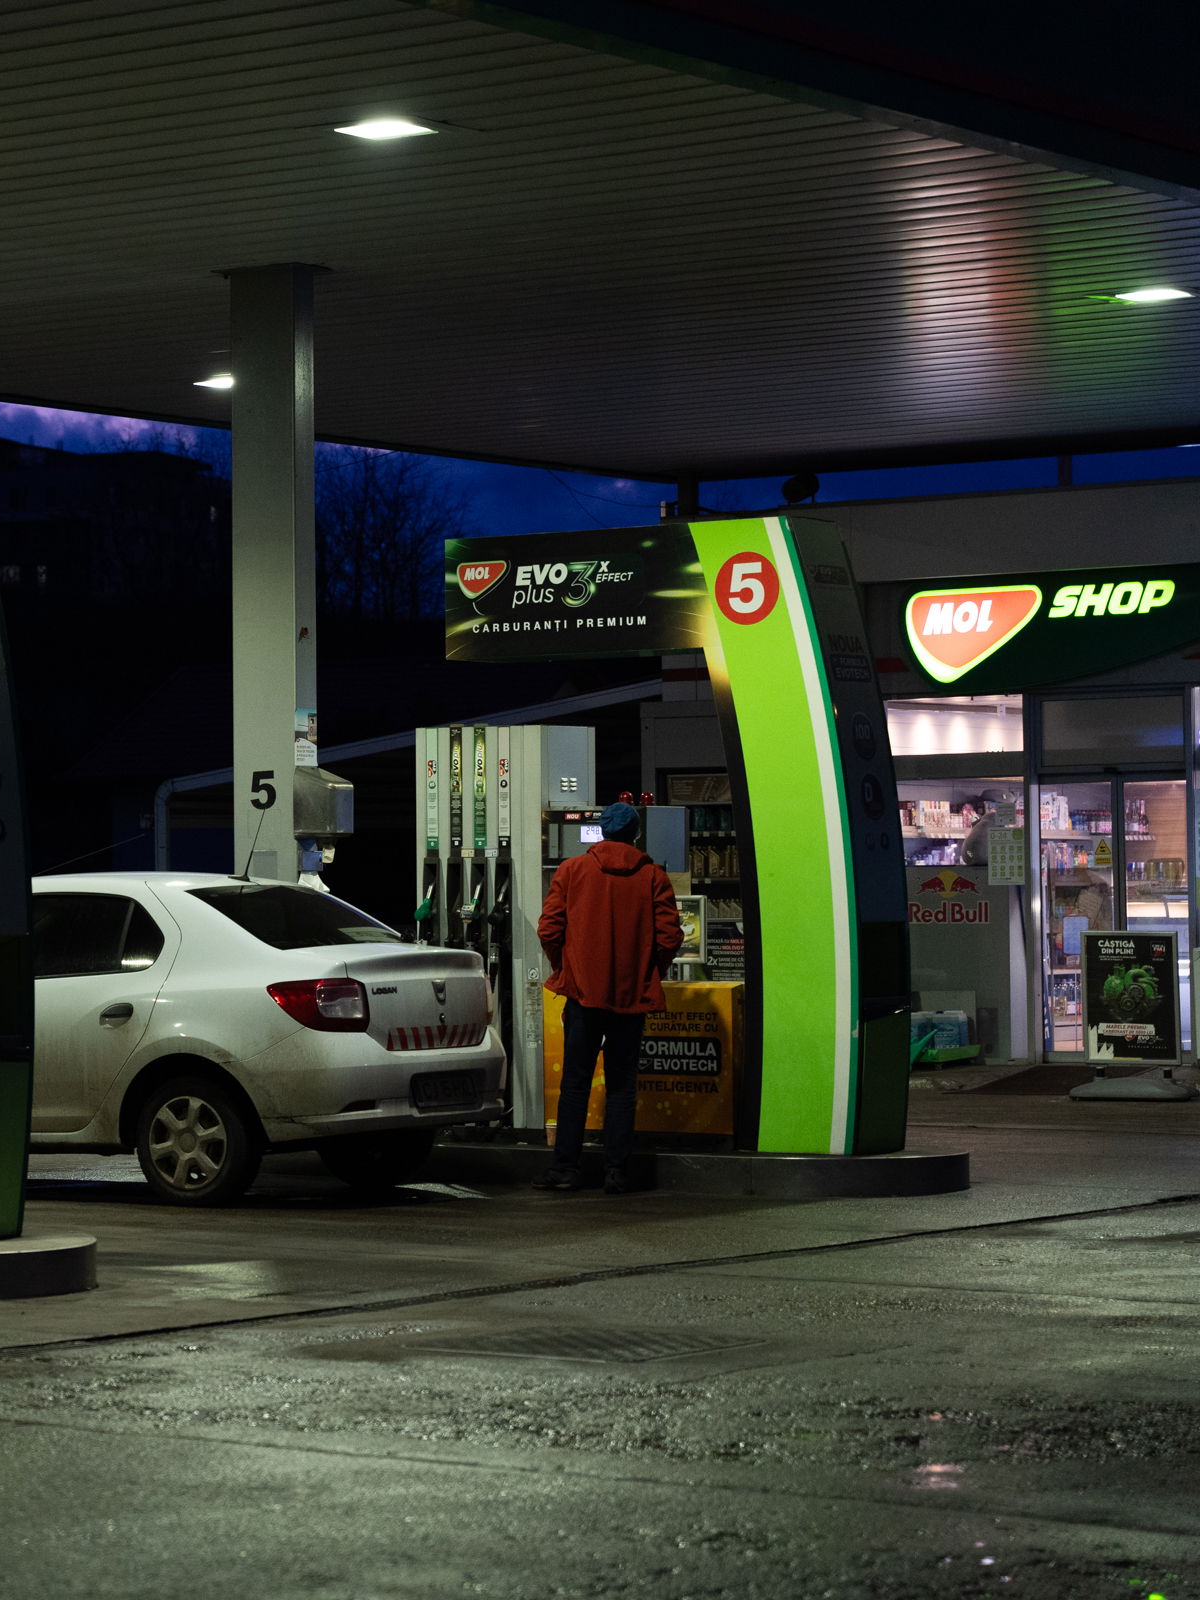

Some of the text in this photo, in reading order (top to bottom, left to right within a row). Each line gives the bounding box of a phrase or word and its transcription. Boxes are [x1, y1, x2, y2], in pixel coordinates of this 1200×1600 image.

[464, 567, 490, 581] MOL
[515, 563, 567, 586] EVO
[595, 571, 634, 584] EFFECT
[728, 561, 765, 614] 5
[512, 584, 554, 609] plus
[922, 579, 1175, 636] MOL SHOP
[472, 615, 647, 633] CARBURANȚI PREMIUM
[250, 770, 277, 810] 5
[909, 901, 989, 922] Red Bull
[372, 986, 397, 995] LOGAN
[647, 1012, 718, 1022] CELENT EFECT
[704, 1023, 718, 1032] CU
[653, 1058, 718, 1072] EVOTECH
[638, 1079, 719, 1093] NTELIGENTĂ
